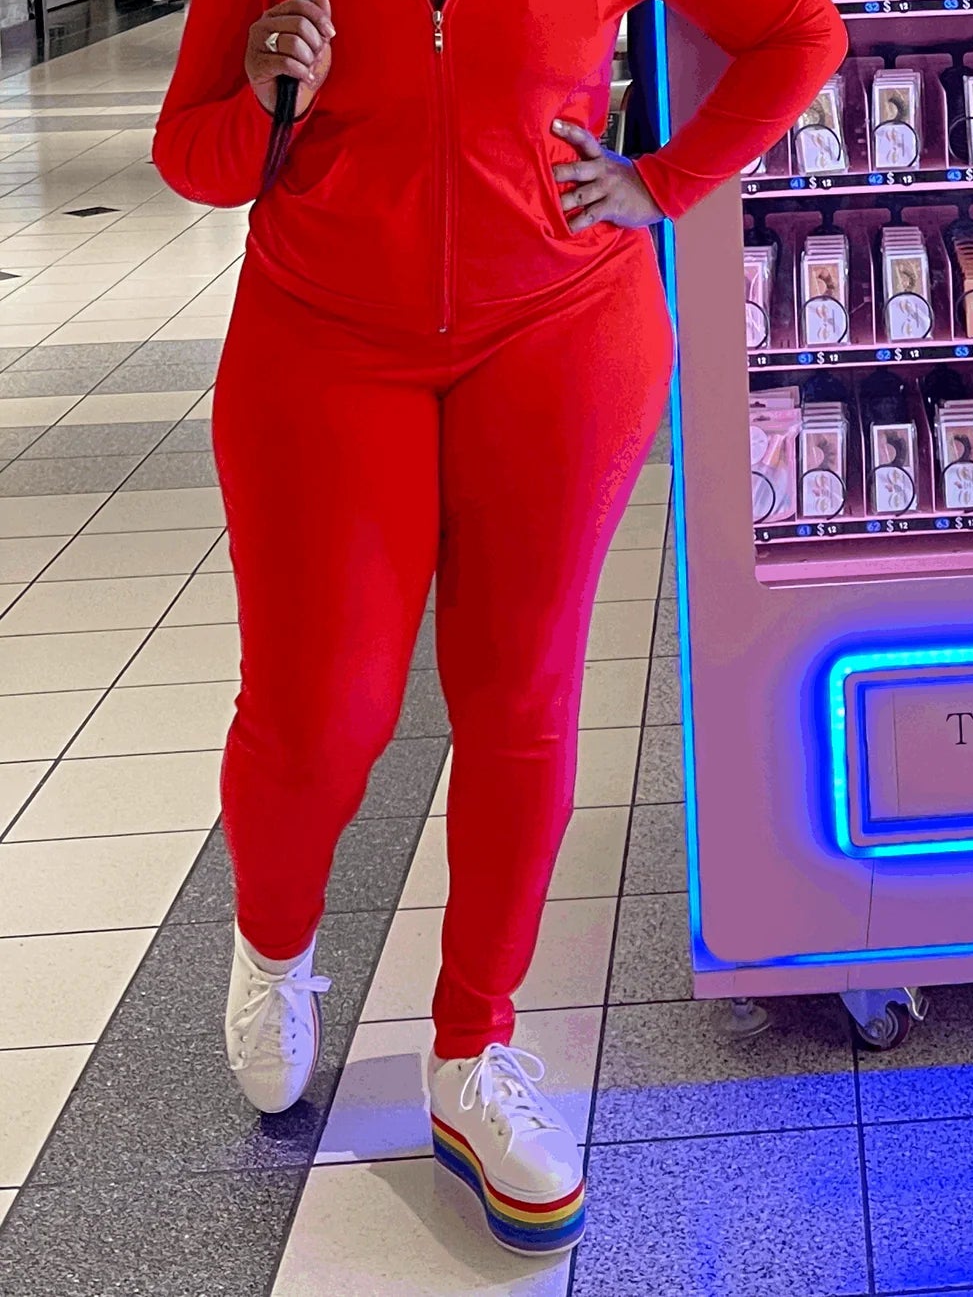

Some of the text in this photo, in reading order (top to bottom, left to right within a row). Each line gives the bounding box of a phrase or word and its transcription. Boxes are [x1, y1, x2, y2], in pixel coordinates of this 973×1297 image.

[817, 351, 825, 365] $
[894, 348, 902, 361] $
[799, 526, 811, 535] 61
[817, 523, 825, 537] $
[867, 521, 881, 531] 62
[886, 519, 894, 533] $
